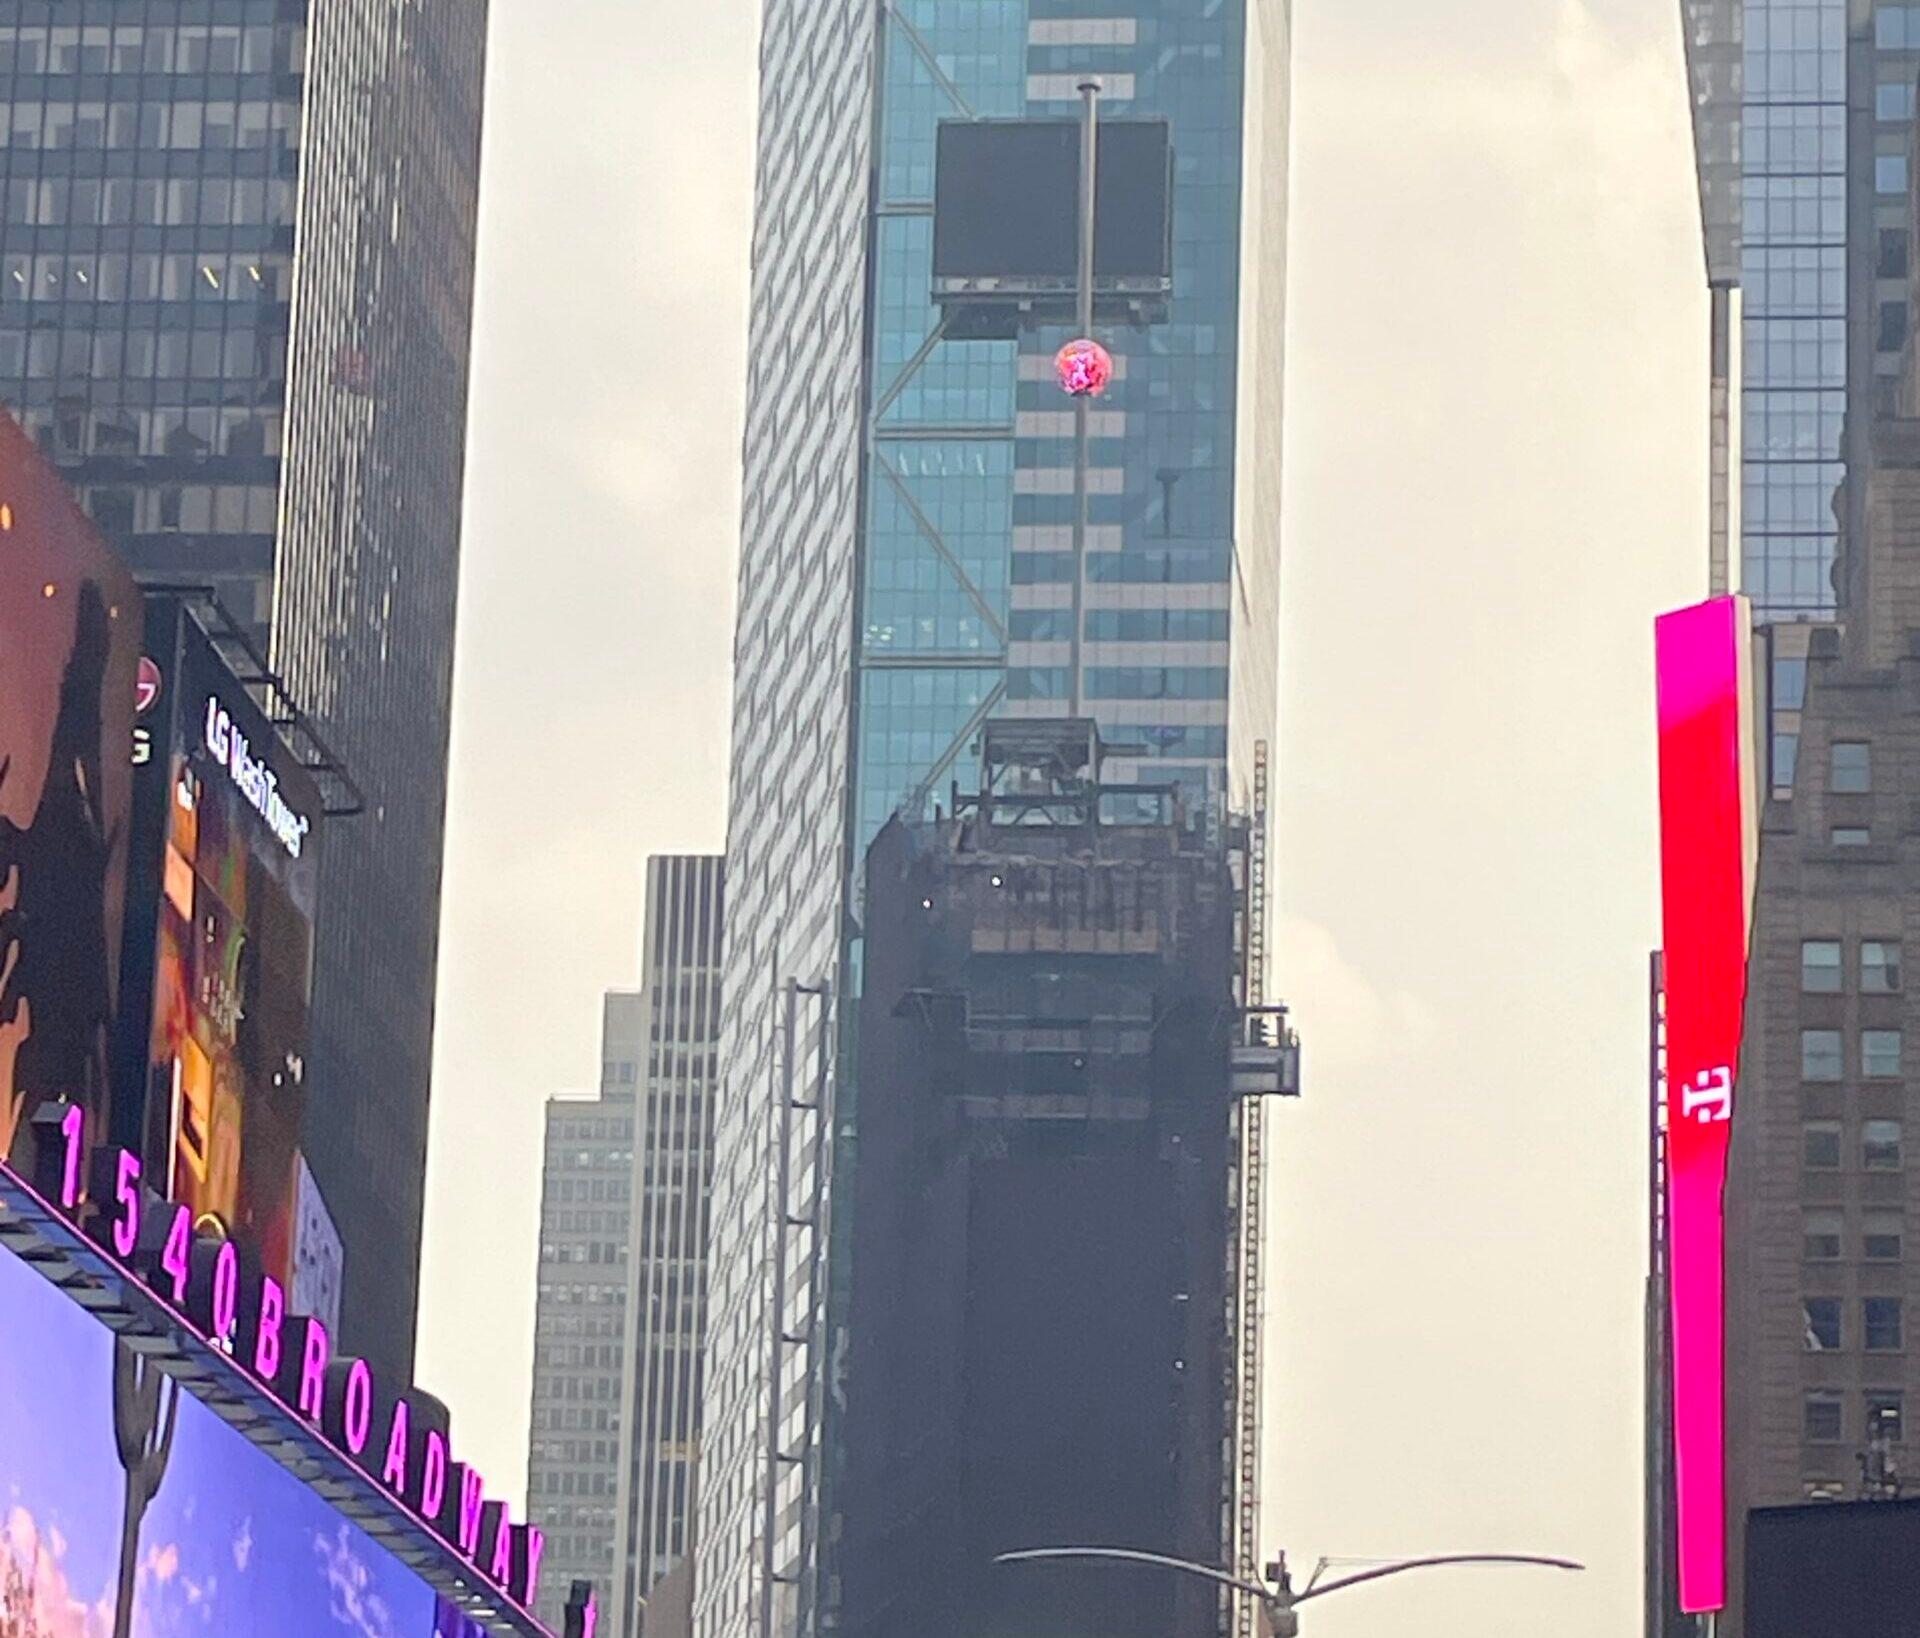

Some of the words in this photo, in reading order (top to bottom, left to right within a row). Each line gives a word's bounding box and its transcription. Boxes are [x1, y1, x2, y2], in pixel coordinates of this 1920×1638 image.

[206, 696, 231, 766] LG
[62, 1104, 238, 1341] 1540
[255, 1276, 545, 1605] BROADWAY
